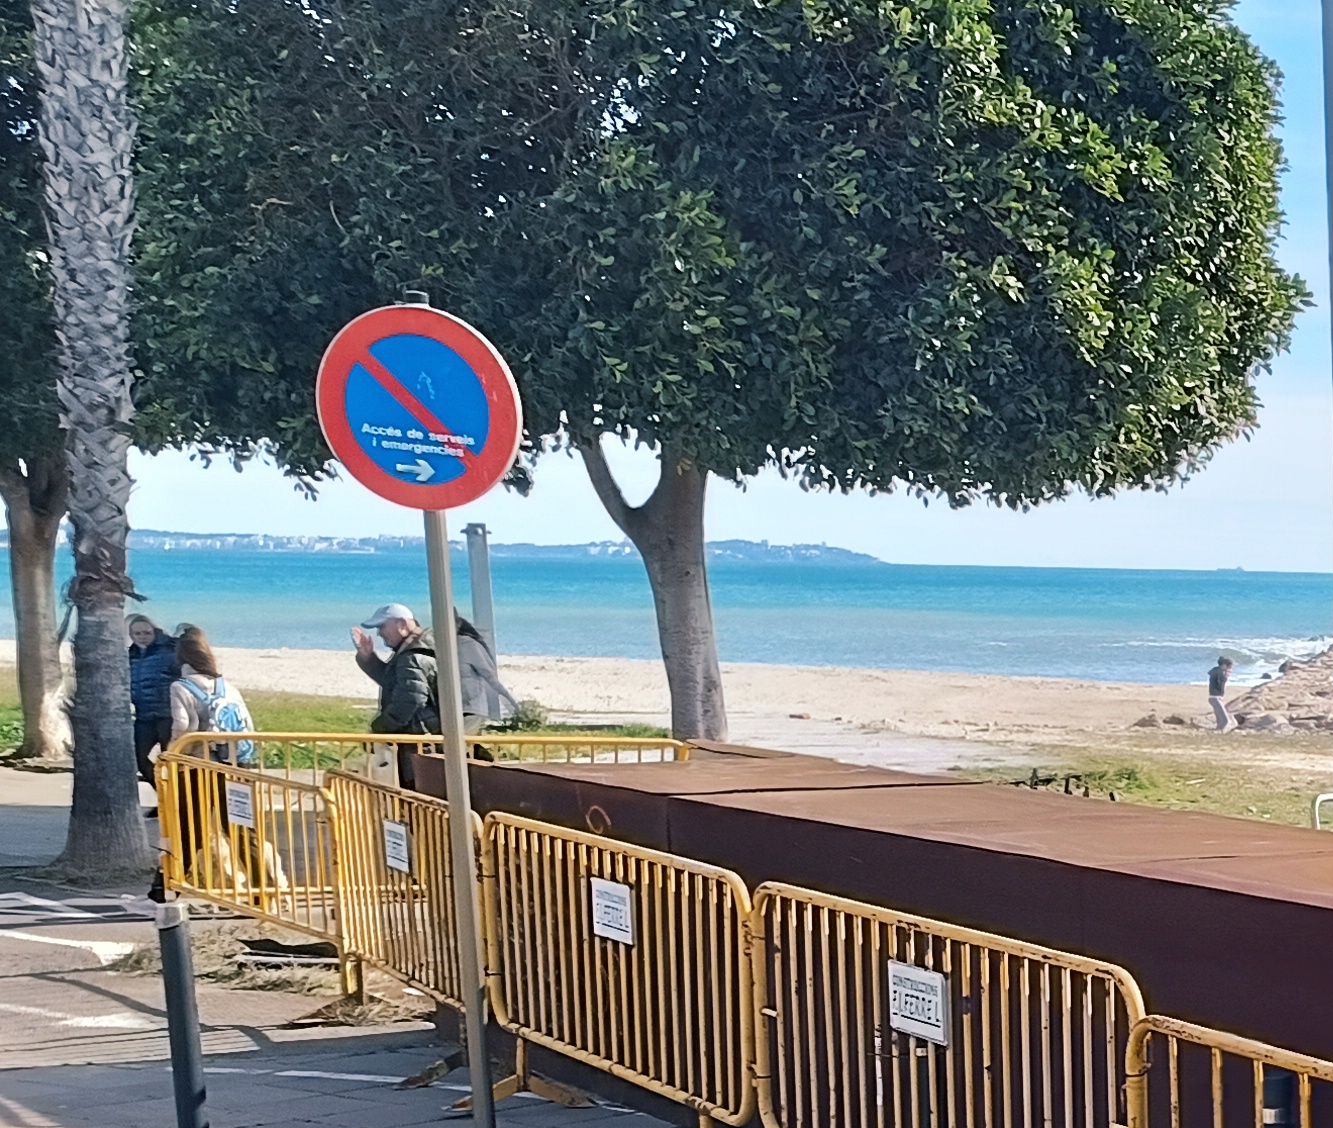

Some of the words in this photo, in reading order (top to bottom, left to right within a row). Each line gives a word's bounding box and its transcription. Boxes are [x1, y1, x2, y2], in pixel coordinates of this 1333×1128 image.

[372, 437, 378, 447] i
[406, 425, 424, 440] de
[428, 432, 475, 446] serveis
